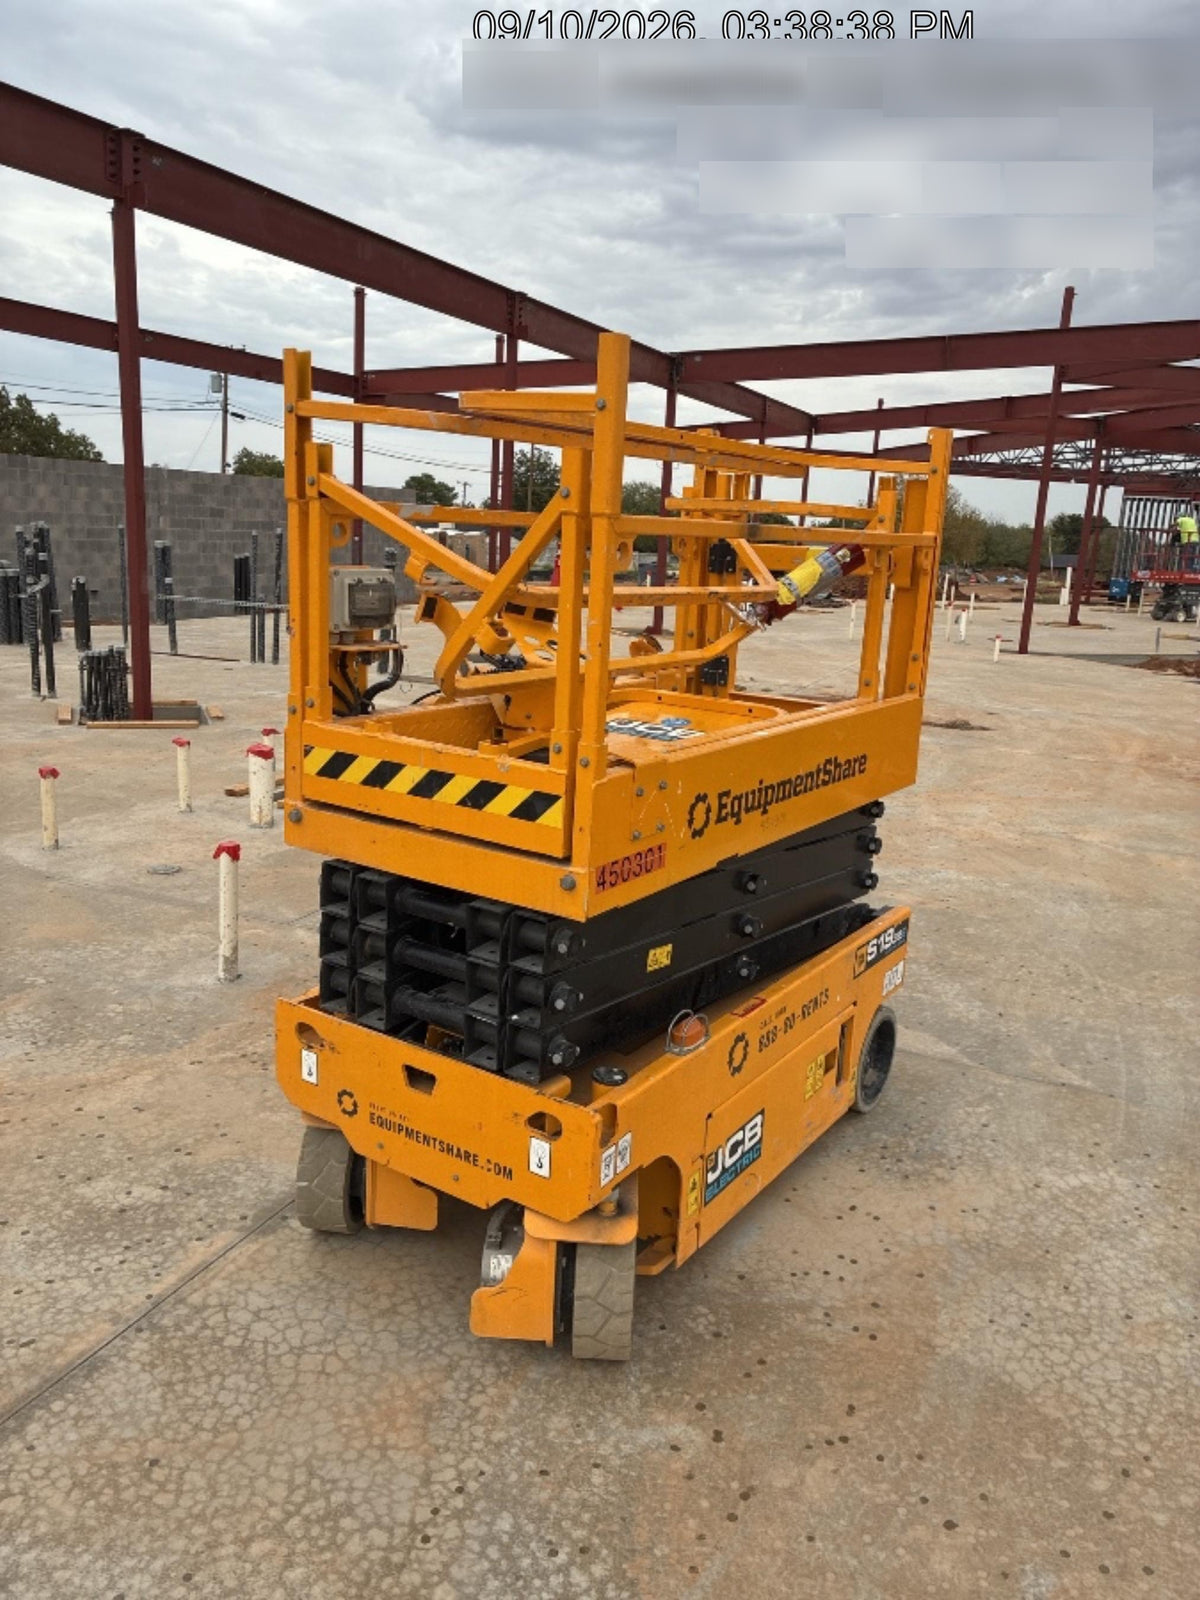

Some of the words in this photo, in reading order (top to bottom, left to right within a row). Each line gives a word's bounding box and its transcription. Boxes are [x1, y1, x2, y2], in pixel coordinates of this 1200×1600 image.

[715, 753, 867, 825] EquipmentShare
[597, 845, 662, 890] 450301
[706, 1144, 761, 1200] ELECTRIC
[707, 1113, 763, 1185] JCB
